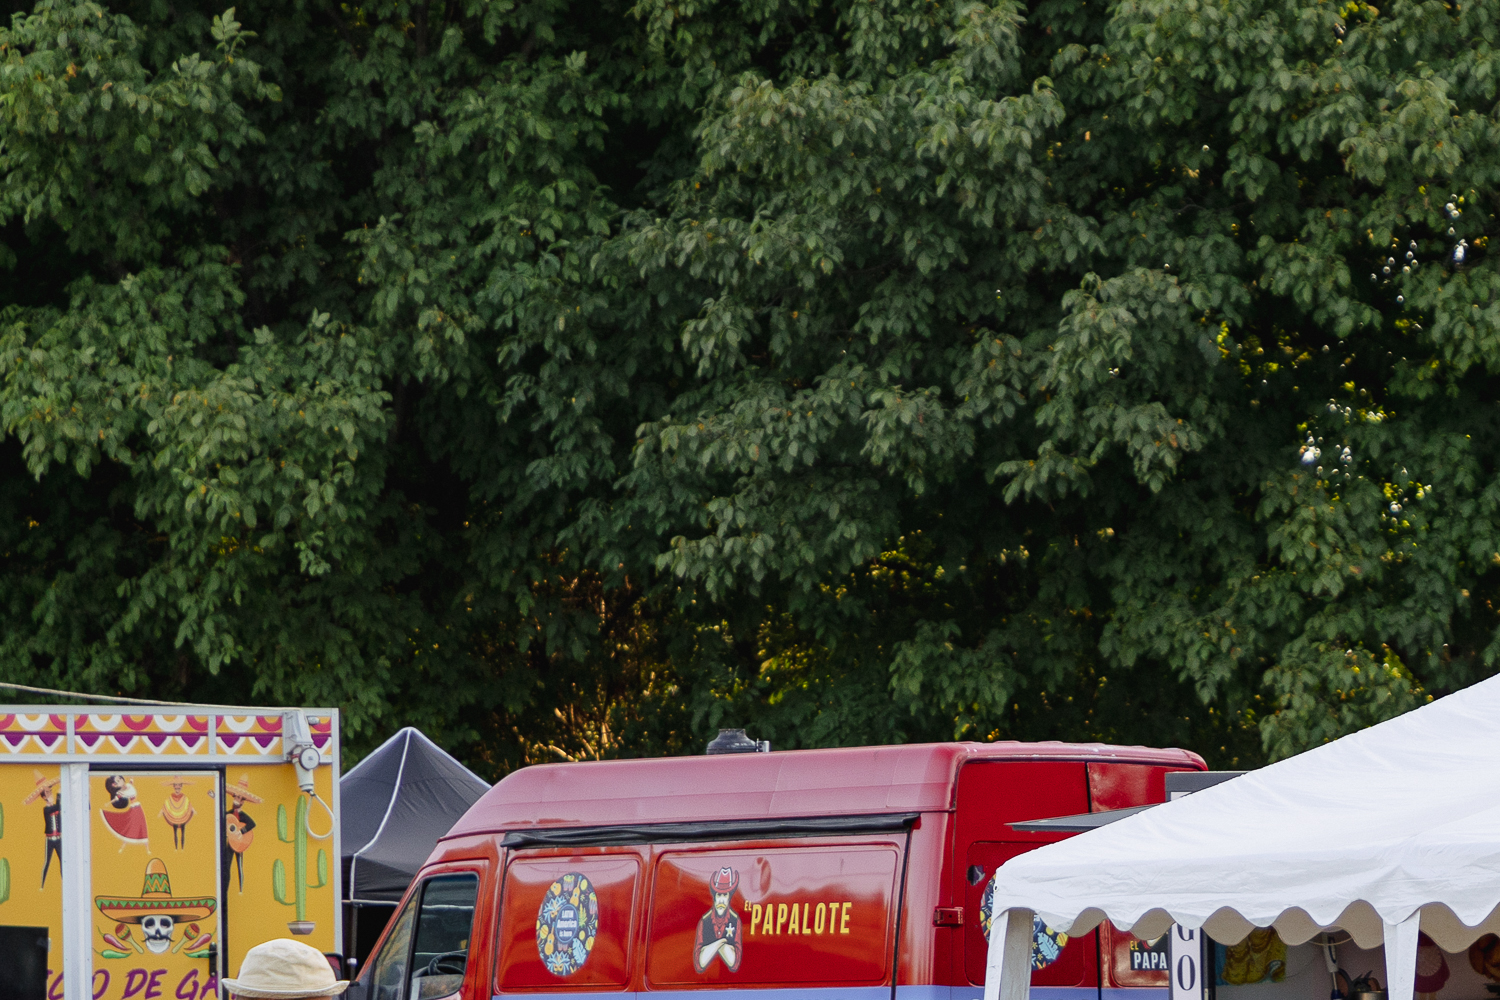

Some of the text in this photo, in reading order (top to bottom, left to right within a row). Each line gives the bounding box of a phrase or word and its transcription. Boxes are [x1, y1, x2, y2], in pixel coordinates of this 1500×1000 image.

[744, 900, 752, 911] EL
[750, 902, 852, 935] PAPALOTE
[1130, 941, 1139, 950] EL
[122, 968, 167, 1000] DE
